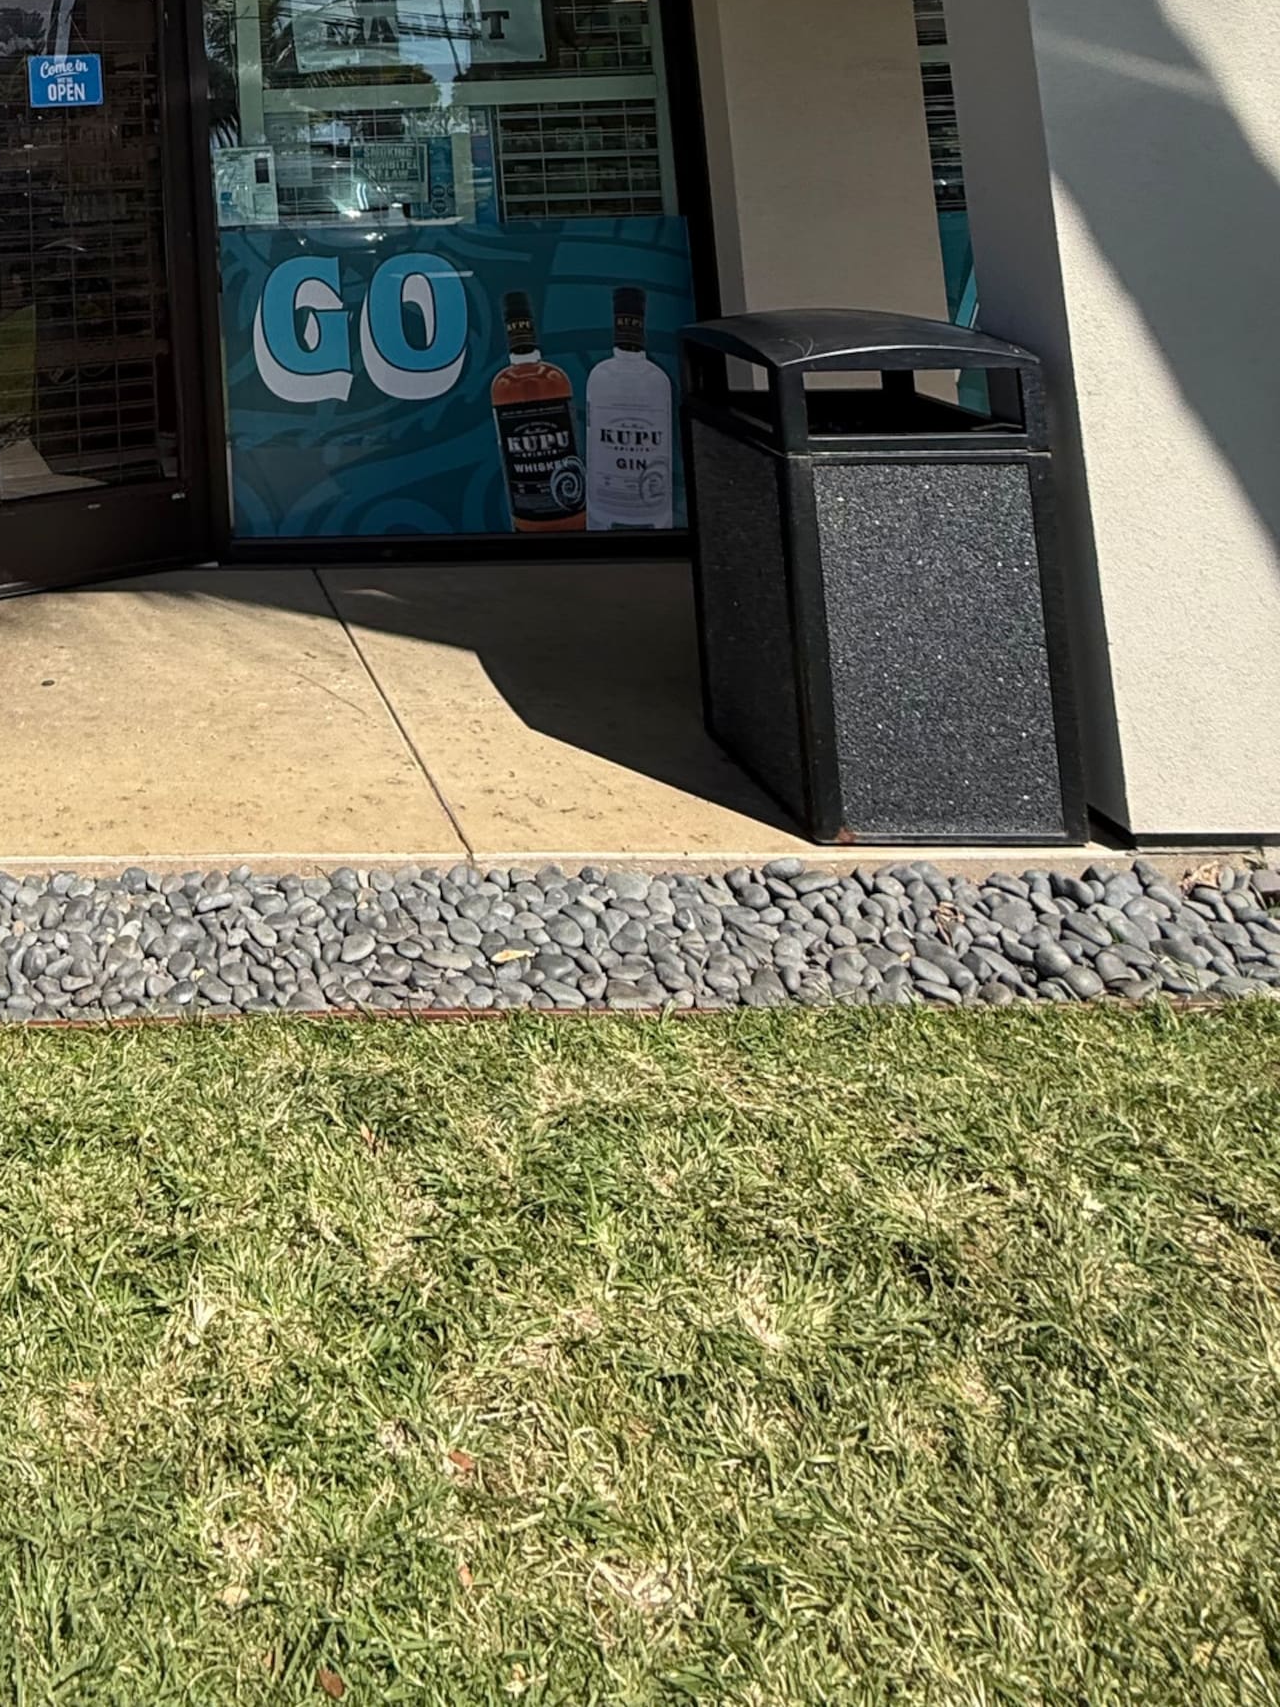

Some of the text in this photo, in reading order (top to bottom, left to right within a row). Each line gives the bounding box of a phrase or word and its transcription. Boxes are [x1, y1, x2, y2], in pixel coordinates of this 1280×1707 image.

[40, 59, 88, 79] Come in
[47, 82, 86, 102] OPEN
[253, 252, 469, 404] GO
[506, 430, 570, 453] KUPU
[599, 428, 663, 446] KUPU
[513, 459, 568, 473] WHISKEY
[616, 458, 648, 471] GIN
